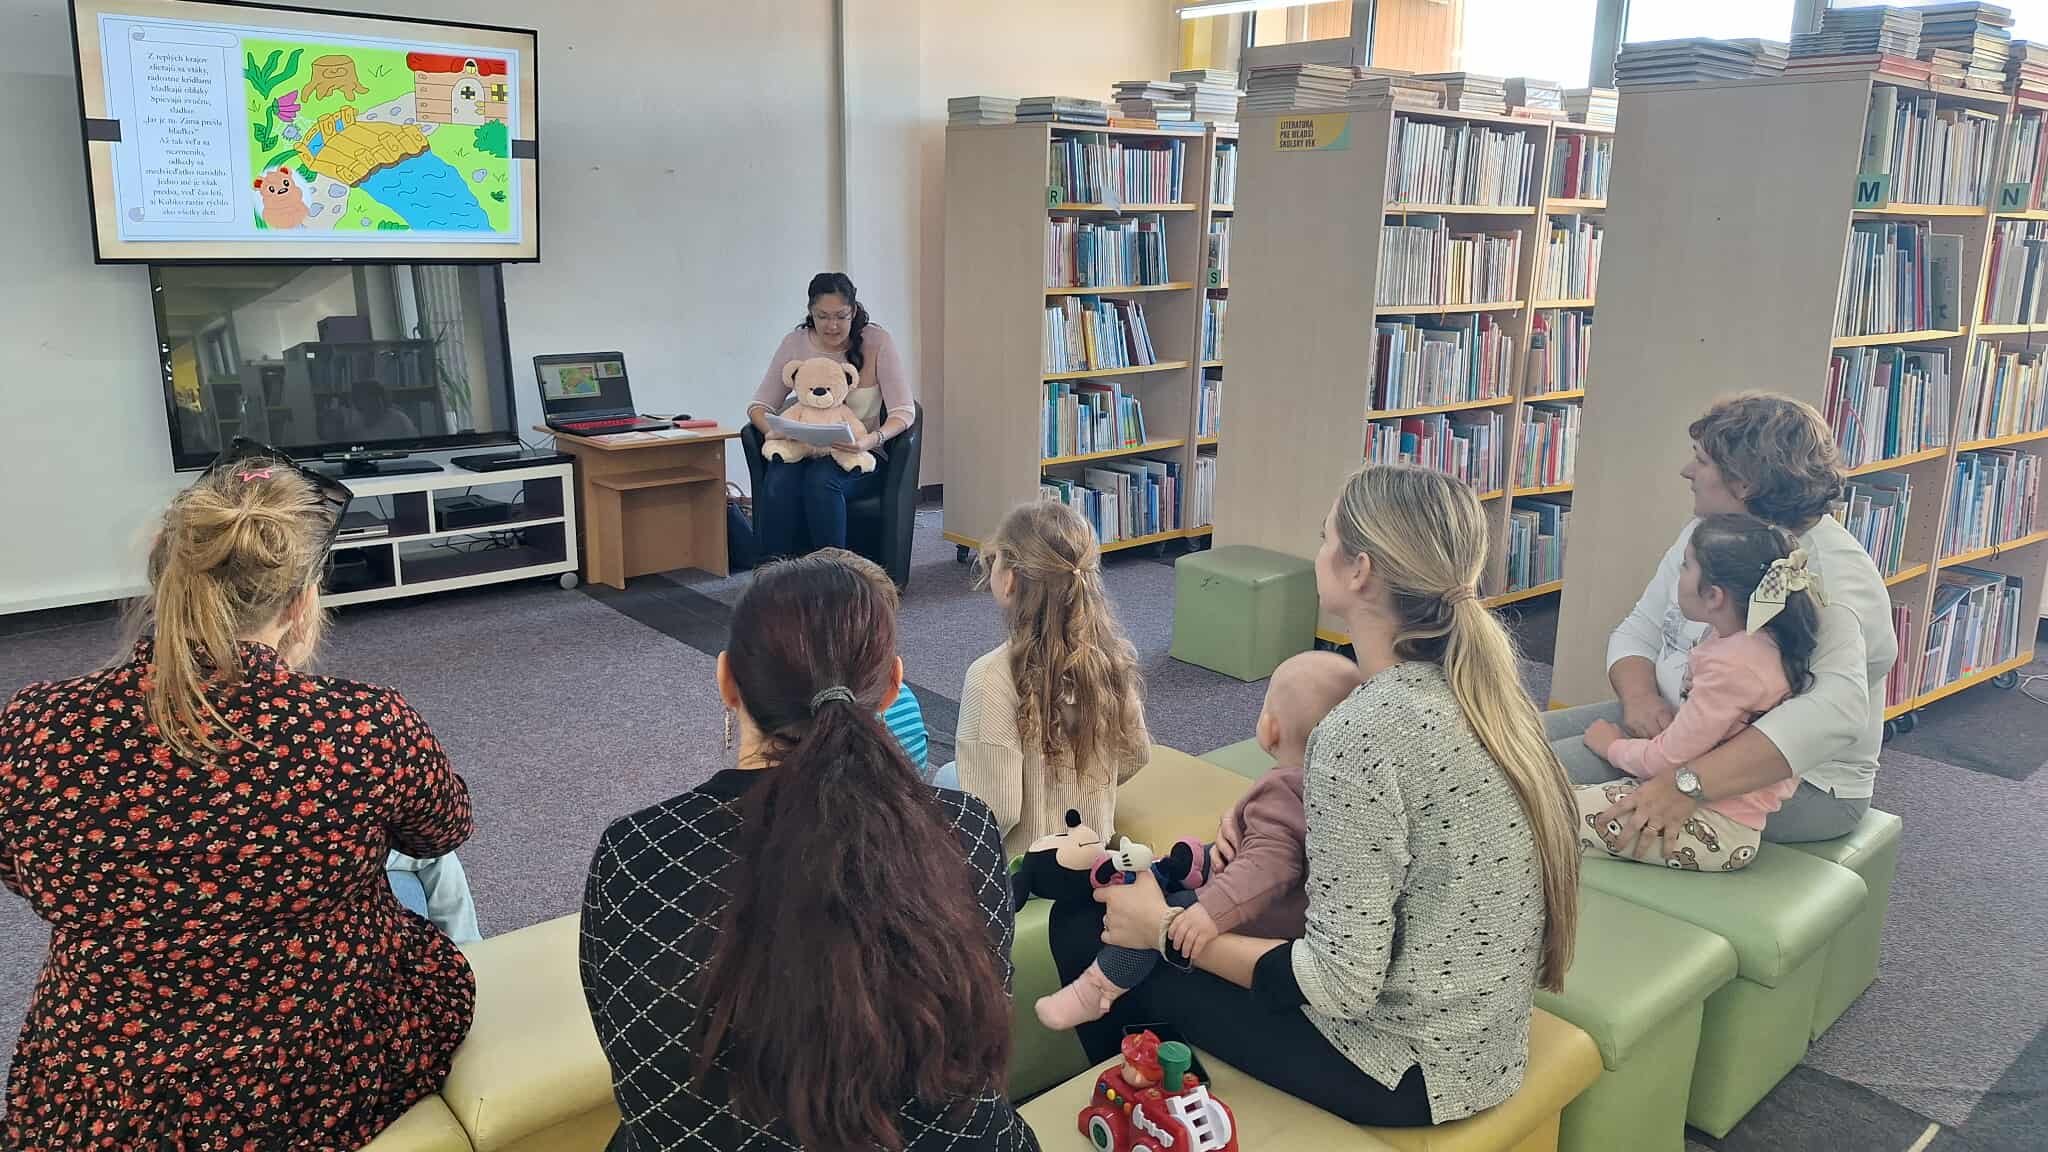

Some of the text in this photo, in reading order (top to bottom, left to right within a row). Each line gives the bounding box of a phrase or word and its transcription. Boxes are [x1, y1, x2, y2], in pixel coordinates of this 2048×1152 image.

[1050, 190, 1058, 204] R
[1858, 182, 1880, 202] M
[2002, 188, 2020, 206] N
[1210, 272, 1217, 284] S
